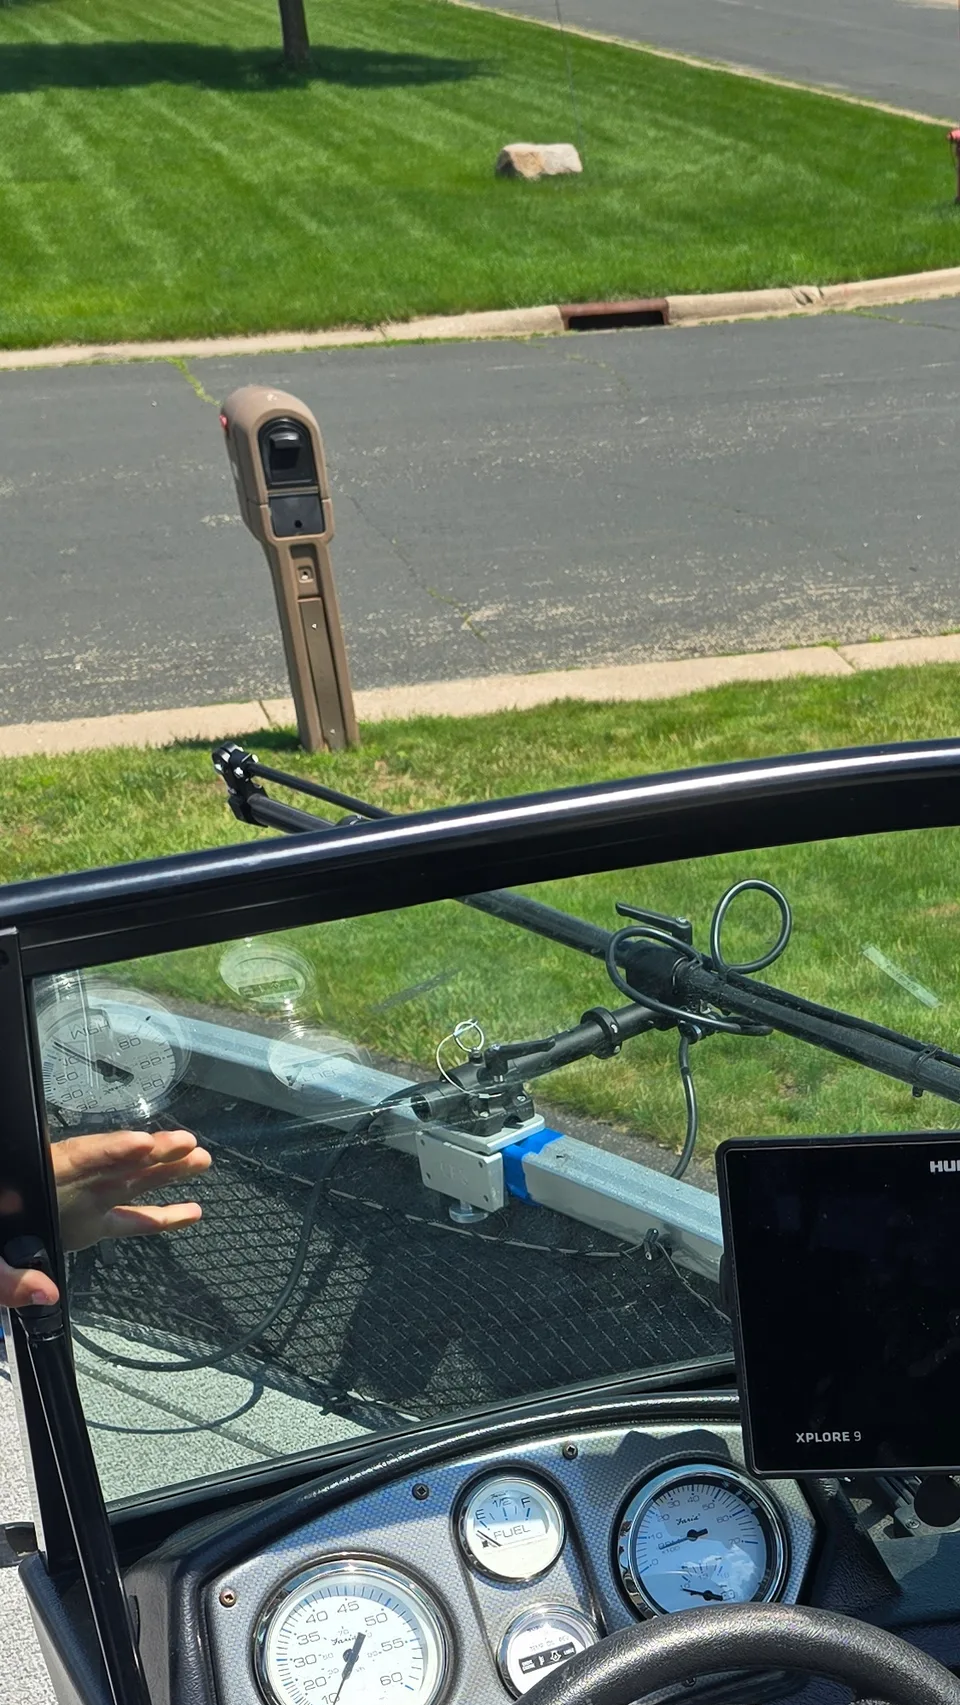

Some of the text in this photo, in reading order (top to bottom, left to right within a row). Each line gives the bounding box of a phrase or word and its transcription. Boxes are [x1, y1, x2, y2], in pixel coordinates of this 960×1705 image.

[795, 1430, 862, 1443] XPLORE 9
[520, 1496, 531, 1509] F
[667, 1500, 681, 1509] 30
[687, 1495, 700, 1504] 40
[475, 1508, 486, 1521] E
[493, 1525, 531, 1541] FUEL
[337, 1601, 360, 1614] 45
[305, 1610, 329, 1625] 40
[364, 1612, 389, 1627] 50
[296, 1631, 321, 1646] 35
[381, 1638, 405, 1652] 55
[293, 1654, 317, 1668] 30
[303, 1676, 327, 1691] 20
[379, 1672, 403, 1687] 60
[321, 1692, 341, 1705] 10
